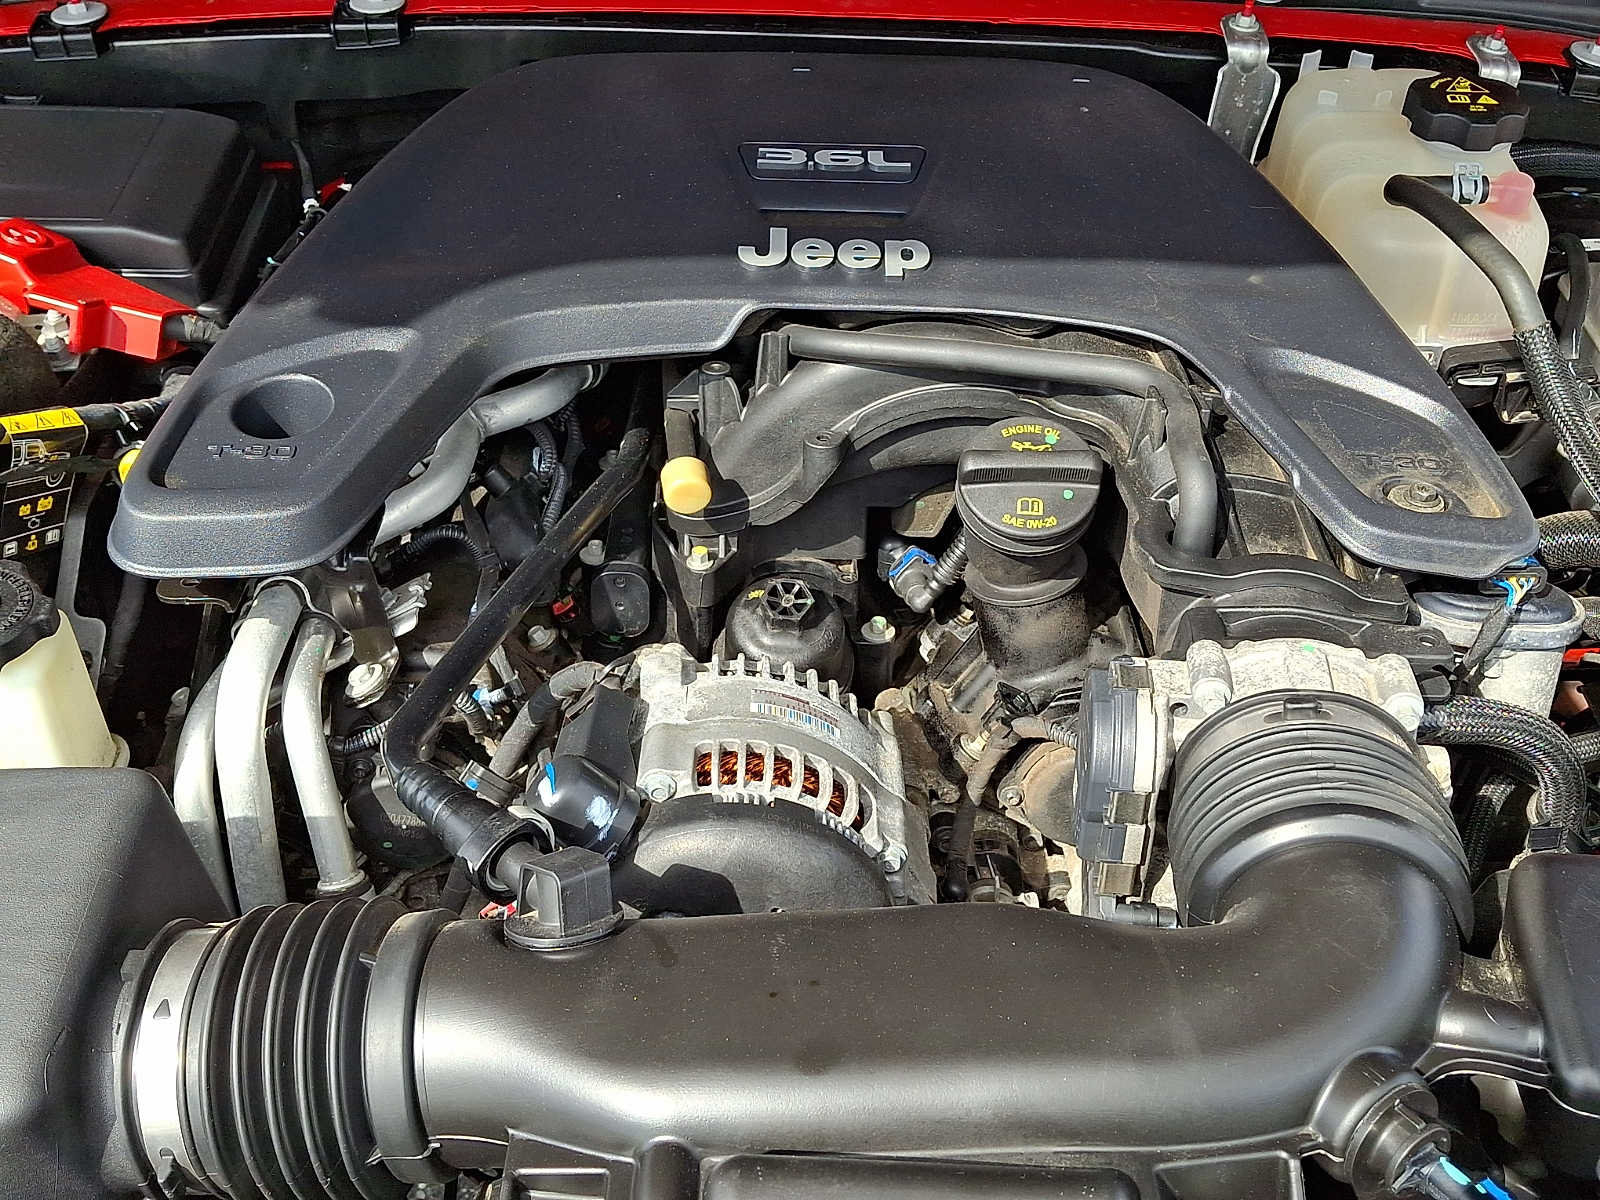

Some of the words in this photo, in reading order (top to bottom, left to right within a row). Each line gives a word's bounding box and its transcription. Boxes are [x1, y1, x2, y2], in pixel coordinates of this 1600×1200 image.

[757, 147, 912, 172] 3.6L
[737, 227, 931, 277] Jeep
[1001, 424, 1043, 438] ENGINE
[1044, 427, 1061, 440] OIL
[207, 444, 298, 461] T-30
[1001, 513, 1025, 528] SAE
[1026, 515, 1058, 529] 0W-20
